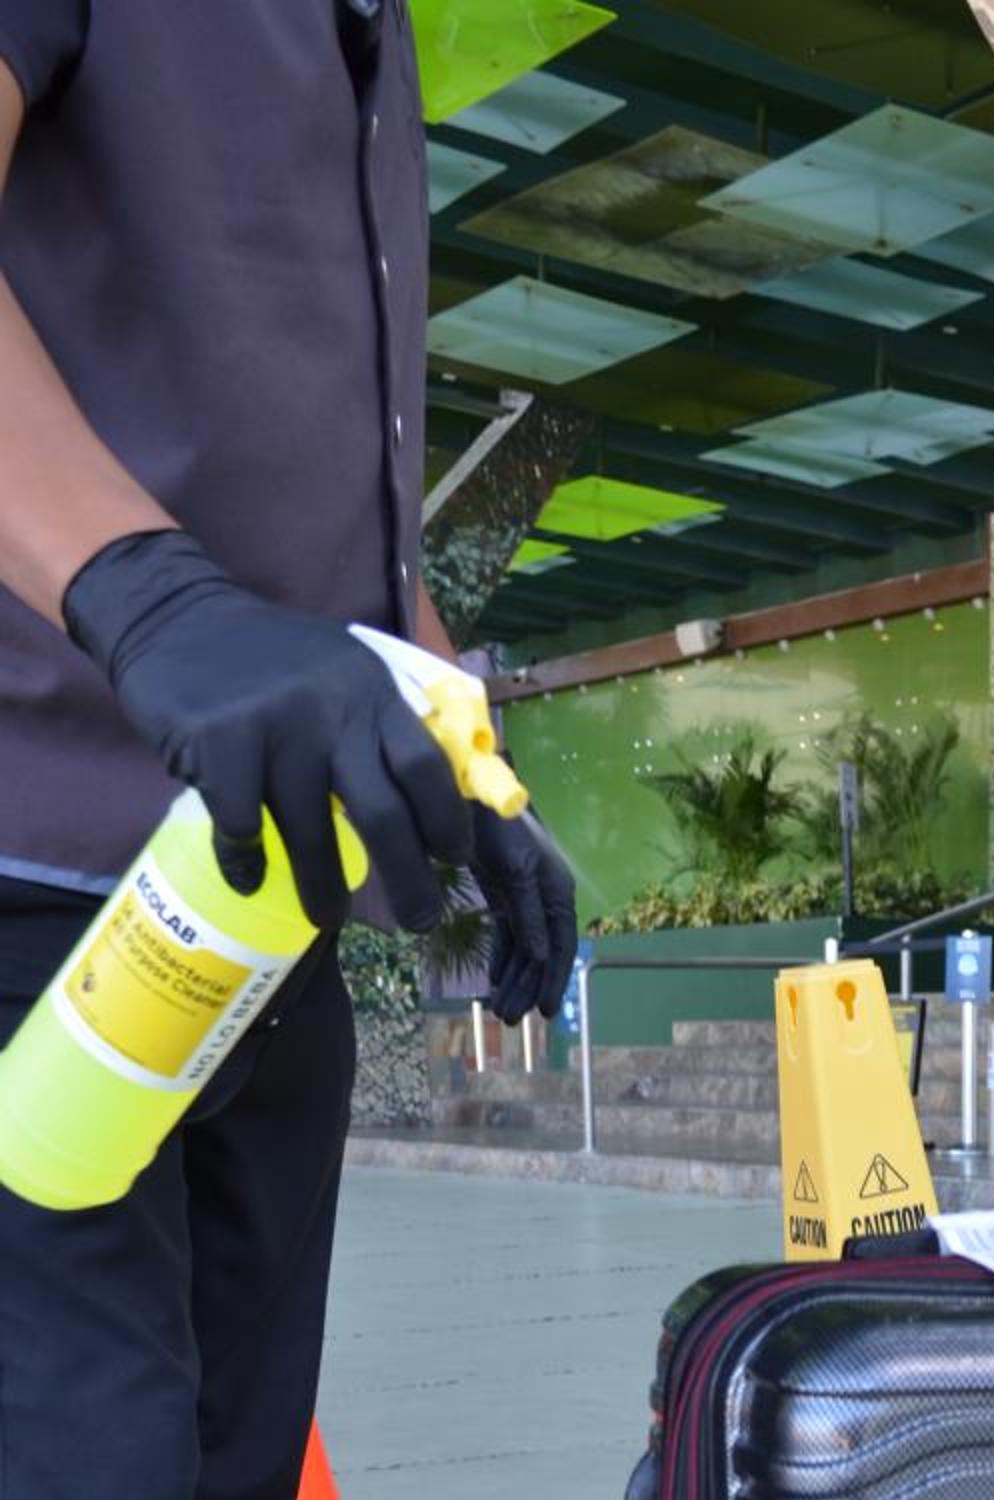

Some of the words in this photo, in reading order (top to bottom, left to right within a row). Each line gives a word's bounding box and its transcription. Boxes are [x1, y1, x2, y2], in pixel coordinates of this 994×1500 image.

[136, 871, 198, 944] ECOLAB
[789, 1214, 828, 1248] CAUTION
[851, 1203, 926, 1239] CAUTION
